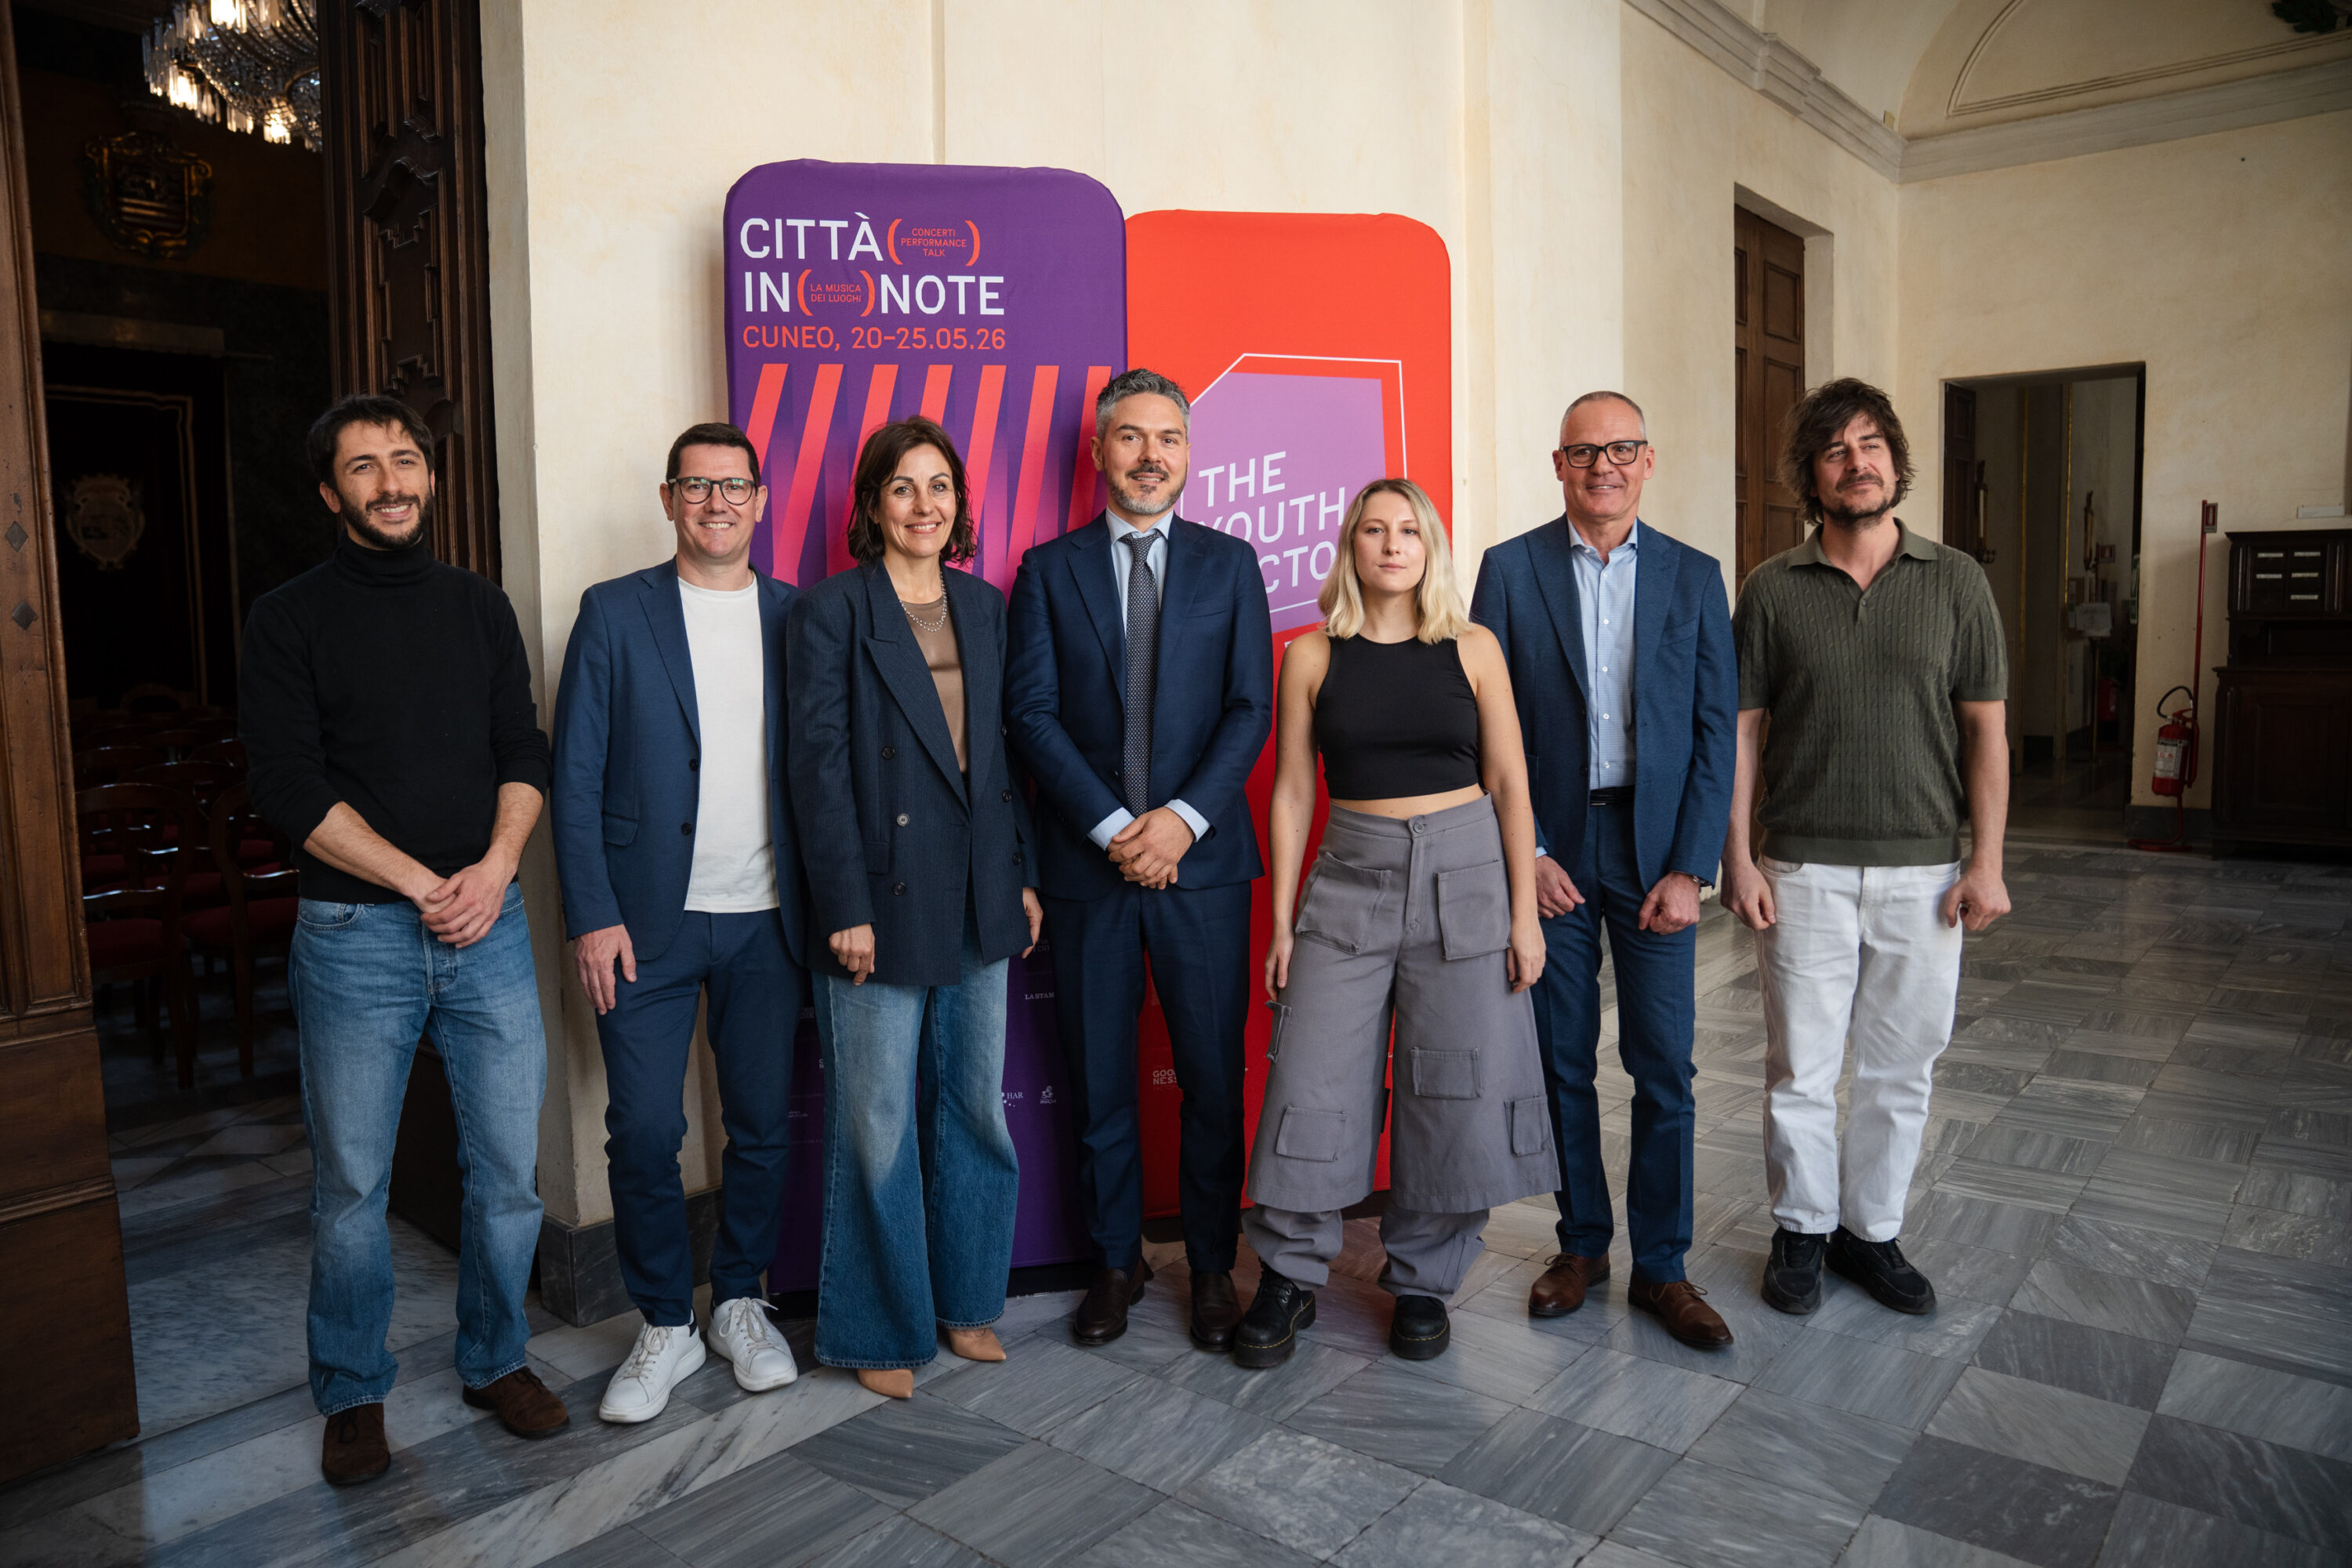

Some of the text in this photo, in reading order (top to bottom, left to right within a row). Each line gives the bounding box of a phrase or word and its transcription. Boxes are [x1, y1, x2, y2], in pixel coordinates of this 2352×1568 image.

[740, 212, 884, 261] CITTÀ
[911, 227, 956, 237] CONCERTI
[901, 238, 967, 247] PERFORMANCE
[923, 248, 946, 257] TALK
[745, 271, 790, 312] IN
[810, 284, 862, 293] LA MUSICA
[811, 293, 862, 303] DEI LUOGHI
[880, 274, 1004, 315] NOTE
[743, 325, 1006, 351] CUNEO, 20-25.05.26
[1198, 451, 1287, 508] THE
[1152, 1069, 1176, 1078] GOO
